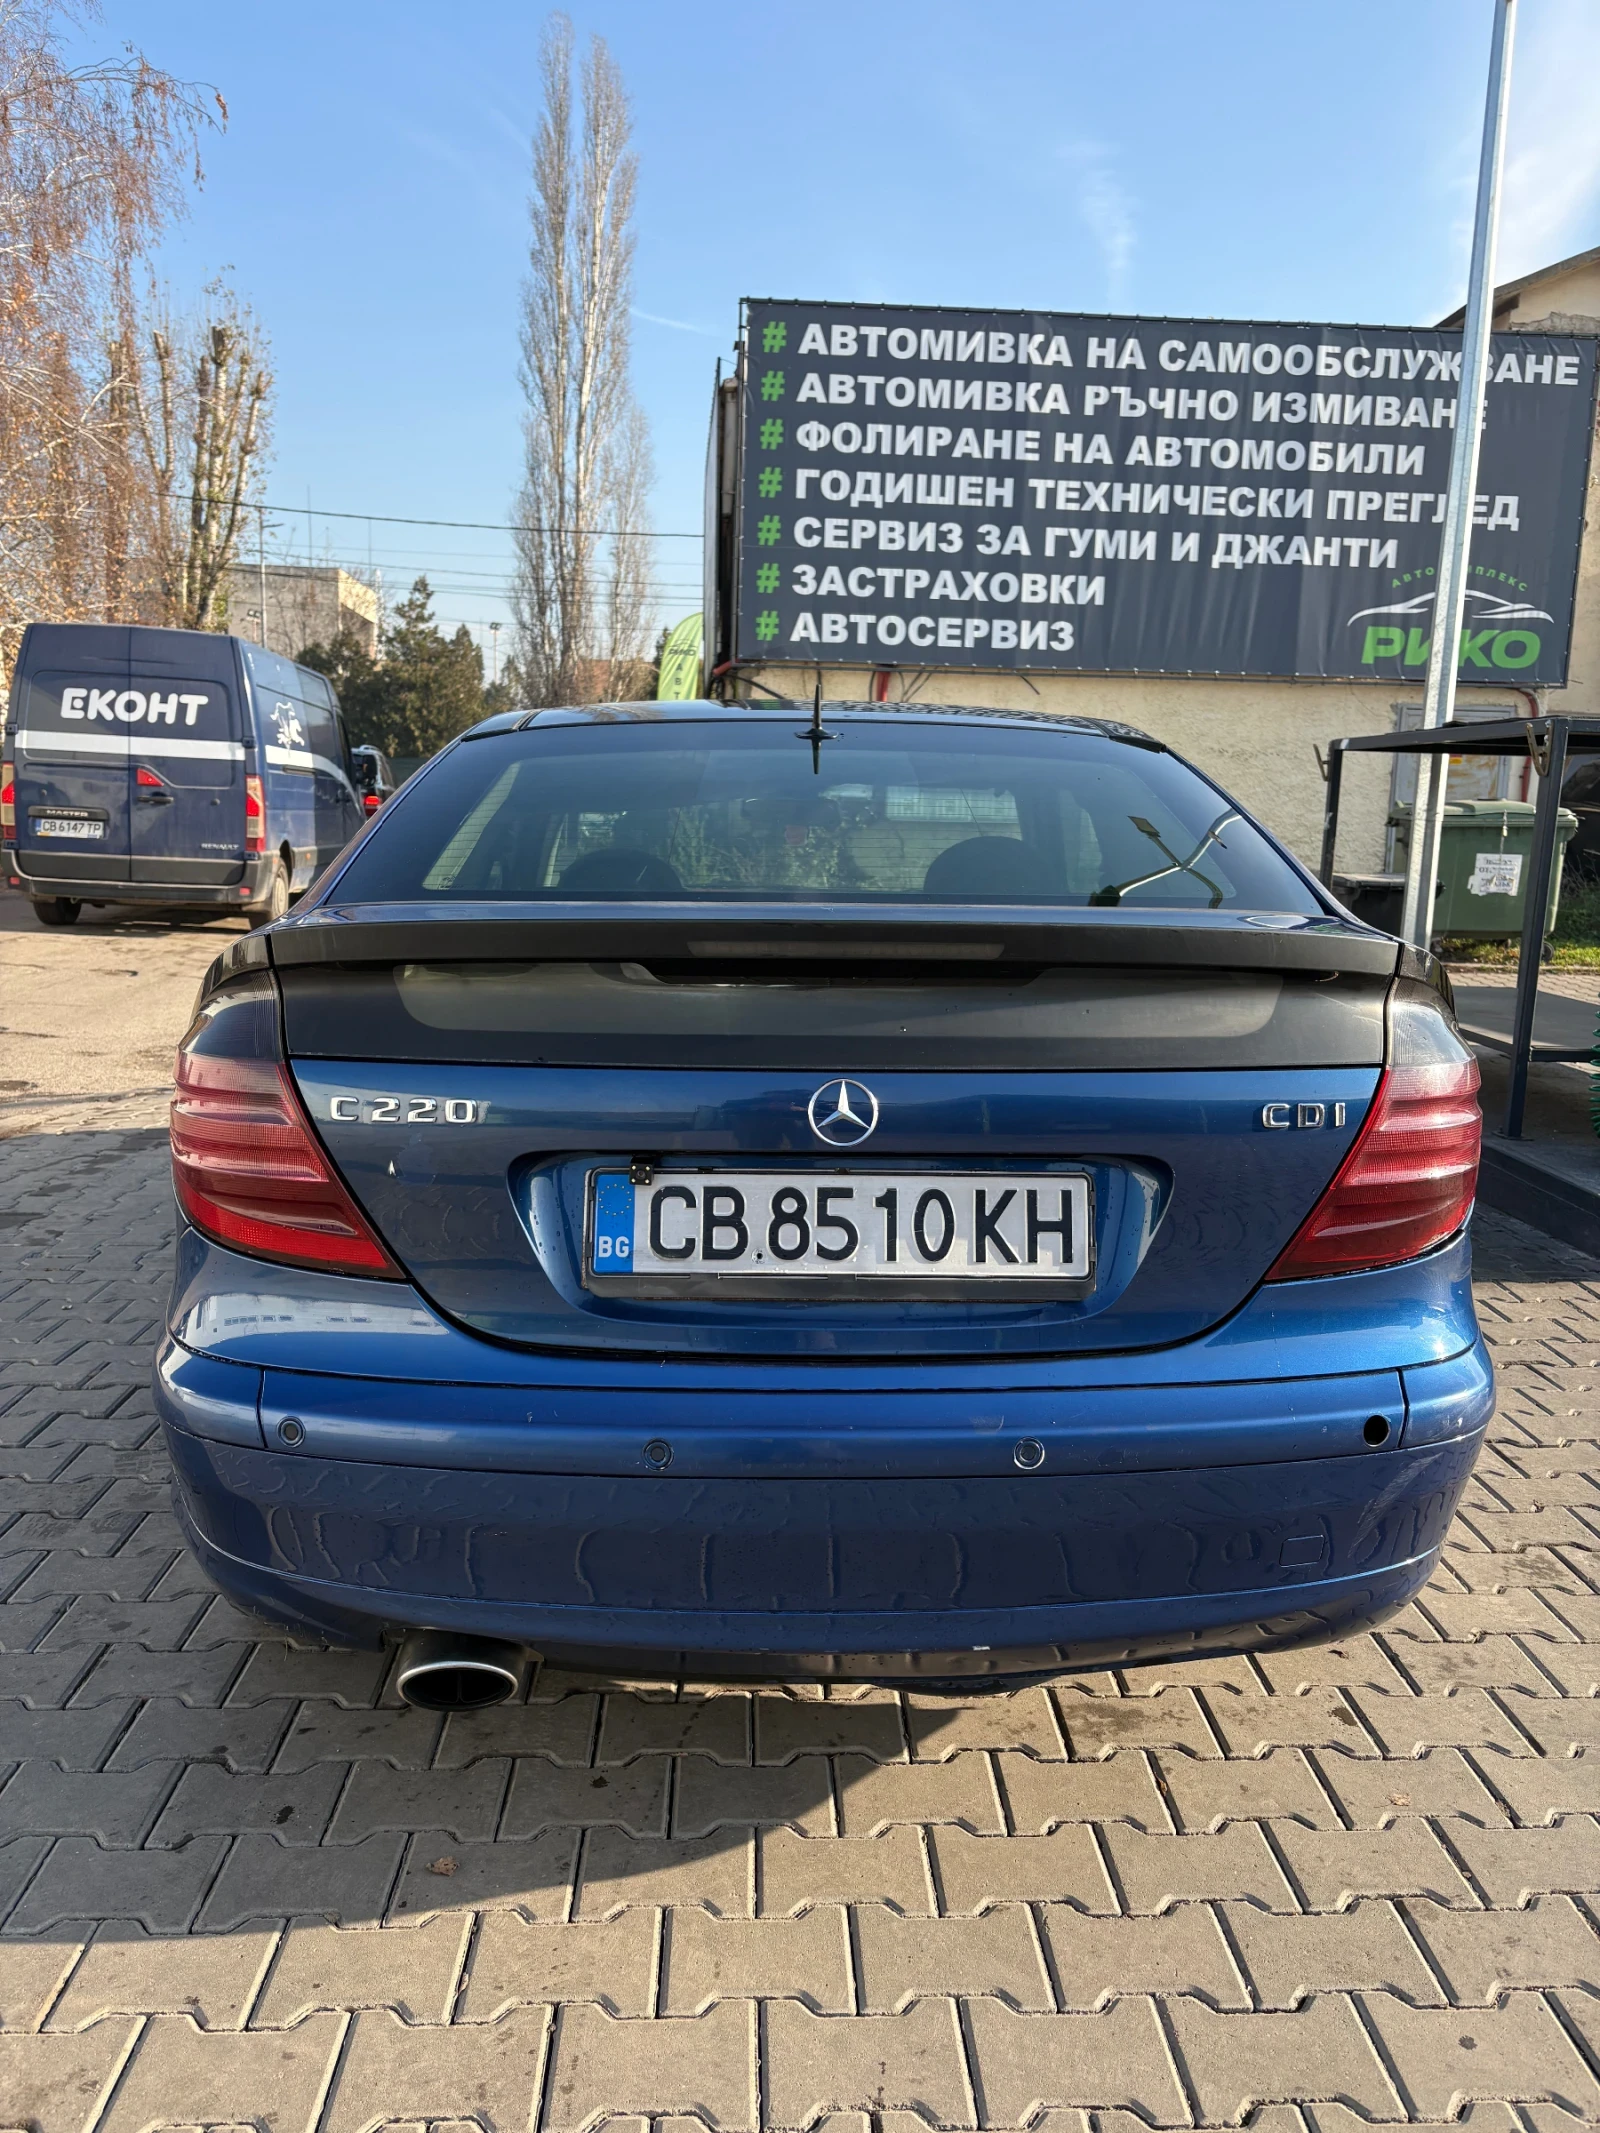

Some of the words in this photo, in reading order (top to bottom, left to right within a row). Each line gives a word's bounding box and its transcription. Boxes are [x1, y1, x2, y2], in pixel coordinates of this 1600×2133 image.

[762, 322, 787, 353] #
[798, 323, 1074, 368] АВТОМИВКА
[1086, 336, 1147, 370] НА
[760, 370, 785, 401] #
[796, 372, 1071, 415] АВТОМИВКА
[1083, 384, 1239, 422] РЪЧНО
[1251, 391, 1488, 430] ИЗМИВАН
[759, 419, 784, 450] #
[796, 420, 1041, 462] ФОЛИРАНЕ
[1053, 431, 1114, 466] НА
[1124, 435, 1426, 476] АВТОМОБИЛИ
[758, 467, 783, 498] #
[795, 468, 1015, 509] ГОДИШЕН
[1027, 478, 1315, 519] ТЕХНИЧЕСКИ
[757, 515, 781, 546] #
[793, 516, 964, 554] СЕРВИЗ
[975, 523, 1032, 557] ЗА
[1044, 526, 1157, 561] ГУМИ
[1171, 531, 1201, 562] И
[1210, 532, 1399, 570] ДЖАНТИ
[756, 563, 780, 594] #
[791, 563, 1106, 606] ЗАСТРАХОВКИ
[755, 611, 779, 642] #
[789, 612, 1075, 652] АВТОСЕРВИЗ
[61, 687, 209, 726] ЕКОНТ
[46, 809, 89, 817] MASTER
[1262, 1102, 1346, 1128] CDI
[597, 1236, 630, 1259] BG
